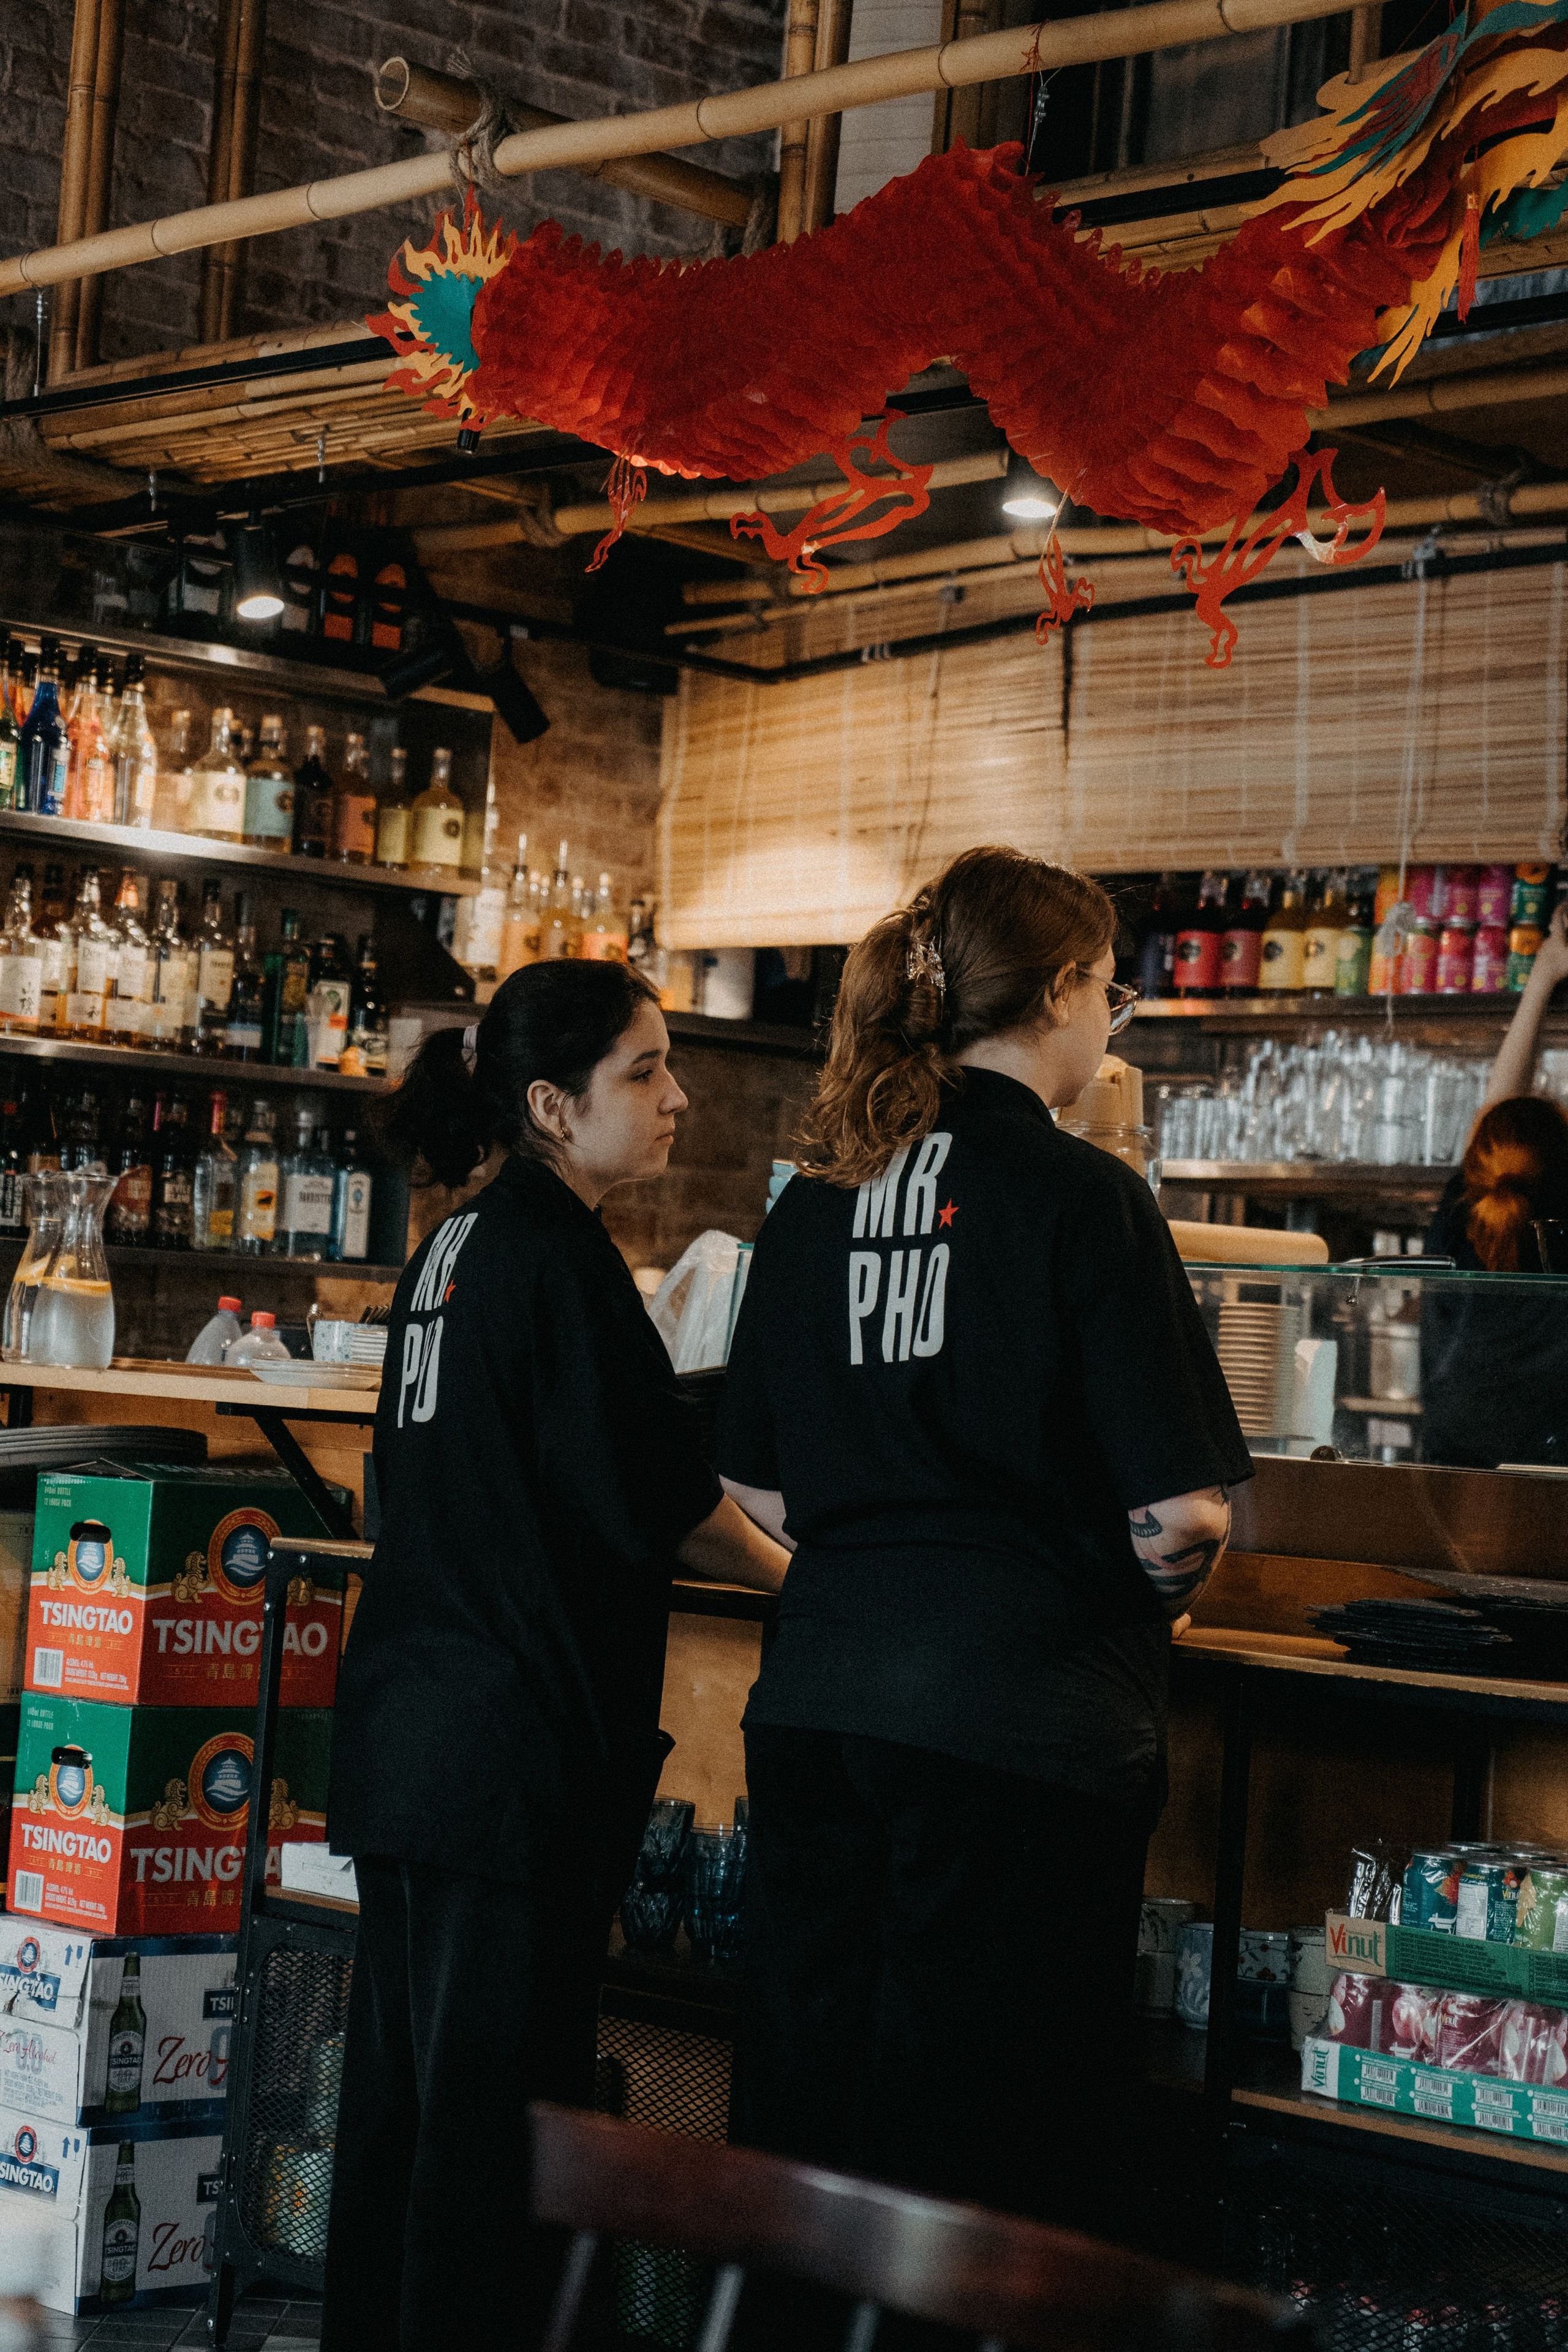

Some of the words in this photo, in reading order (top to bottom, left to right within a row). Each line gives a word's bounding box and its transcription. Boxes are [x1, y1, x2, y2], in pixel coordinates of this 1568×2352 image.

[849, 1243, 950, 1365] PHO
[40, 1600, 133, 1635] TSINGTAO
[153, 1619, 328, 1657] TSINGAO
[206, 1663, 261, 1681] 青島啤
[21, 1823, 111, 1864] TSINGTAO
[186, 1890, 243, 1907] 青島啤
[1330, 1923, 1384, 1967] Vinut
[210, 1997, 234, 2011] TSI
[20, 2039, 58, 2065] Alcohol
[153, 2036, 212, 2084] Zero
[1311, 2047, 1329, 2087] Vinut
[148, 2222, 206, 2272] Zero
